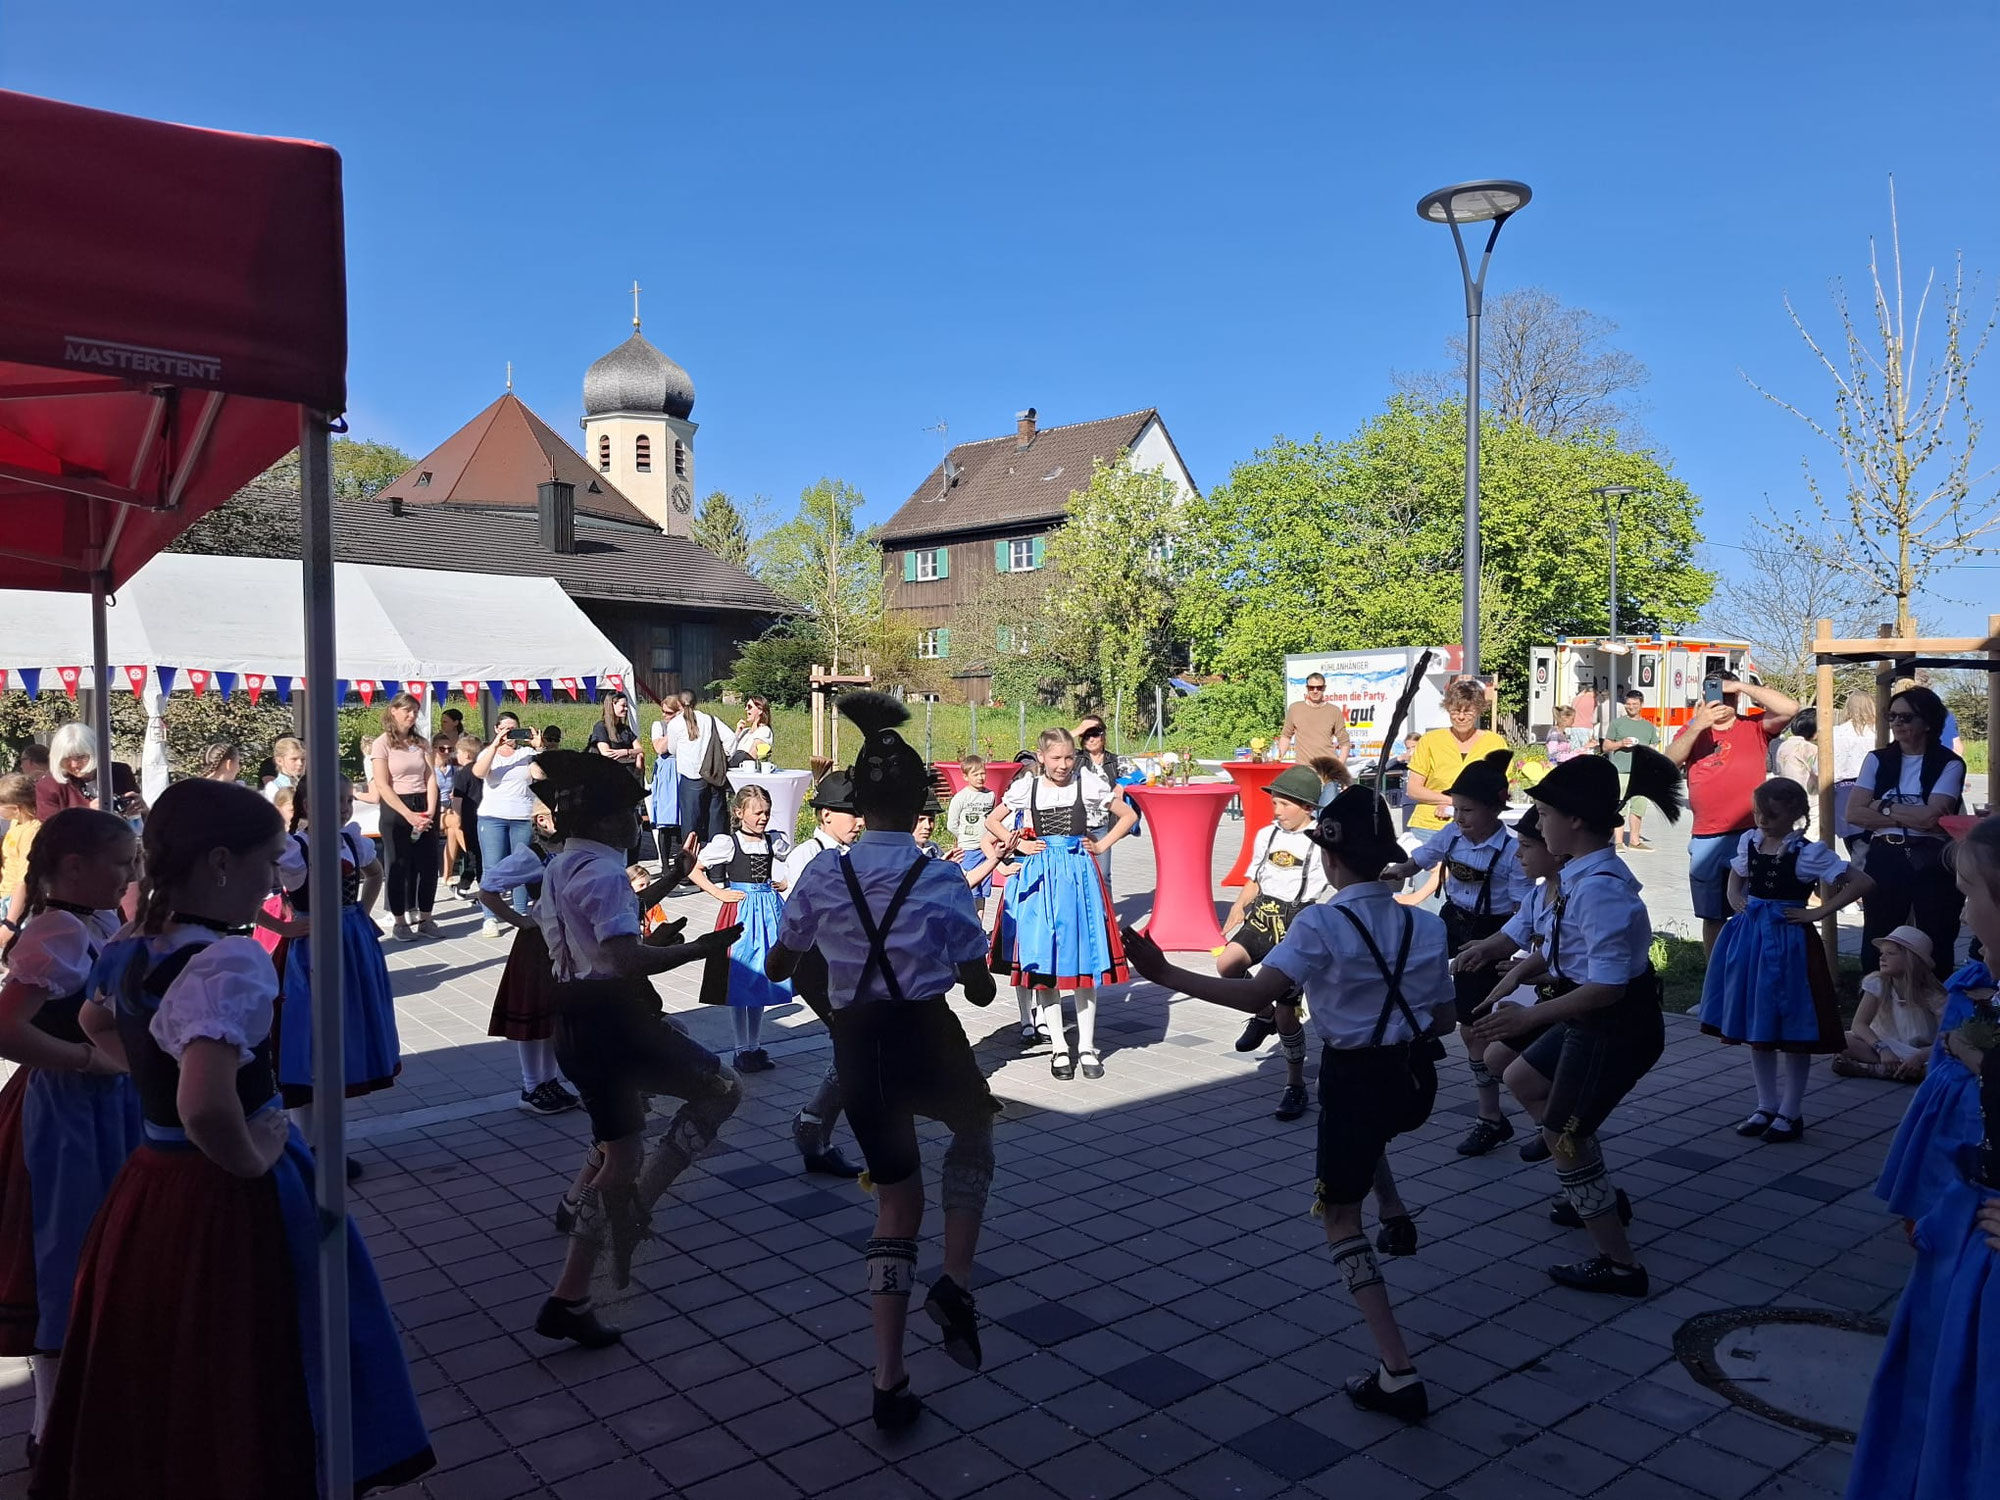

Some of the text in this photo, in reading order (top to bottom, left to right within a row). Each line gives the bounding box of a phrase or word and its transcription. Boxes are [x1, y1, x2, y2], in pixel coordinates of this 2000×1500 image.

[1324, 692, 1348, 702] achen
[1349, 691, 1361, 700] die
[1363, 691, 1387, 702] Party.
[1342, 704, 1375, 726] kgut
